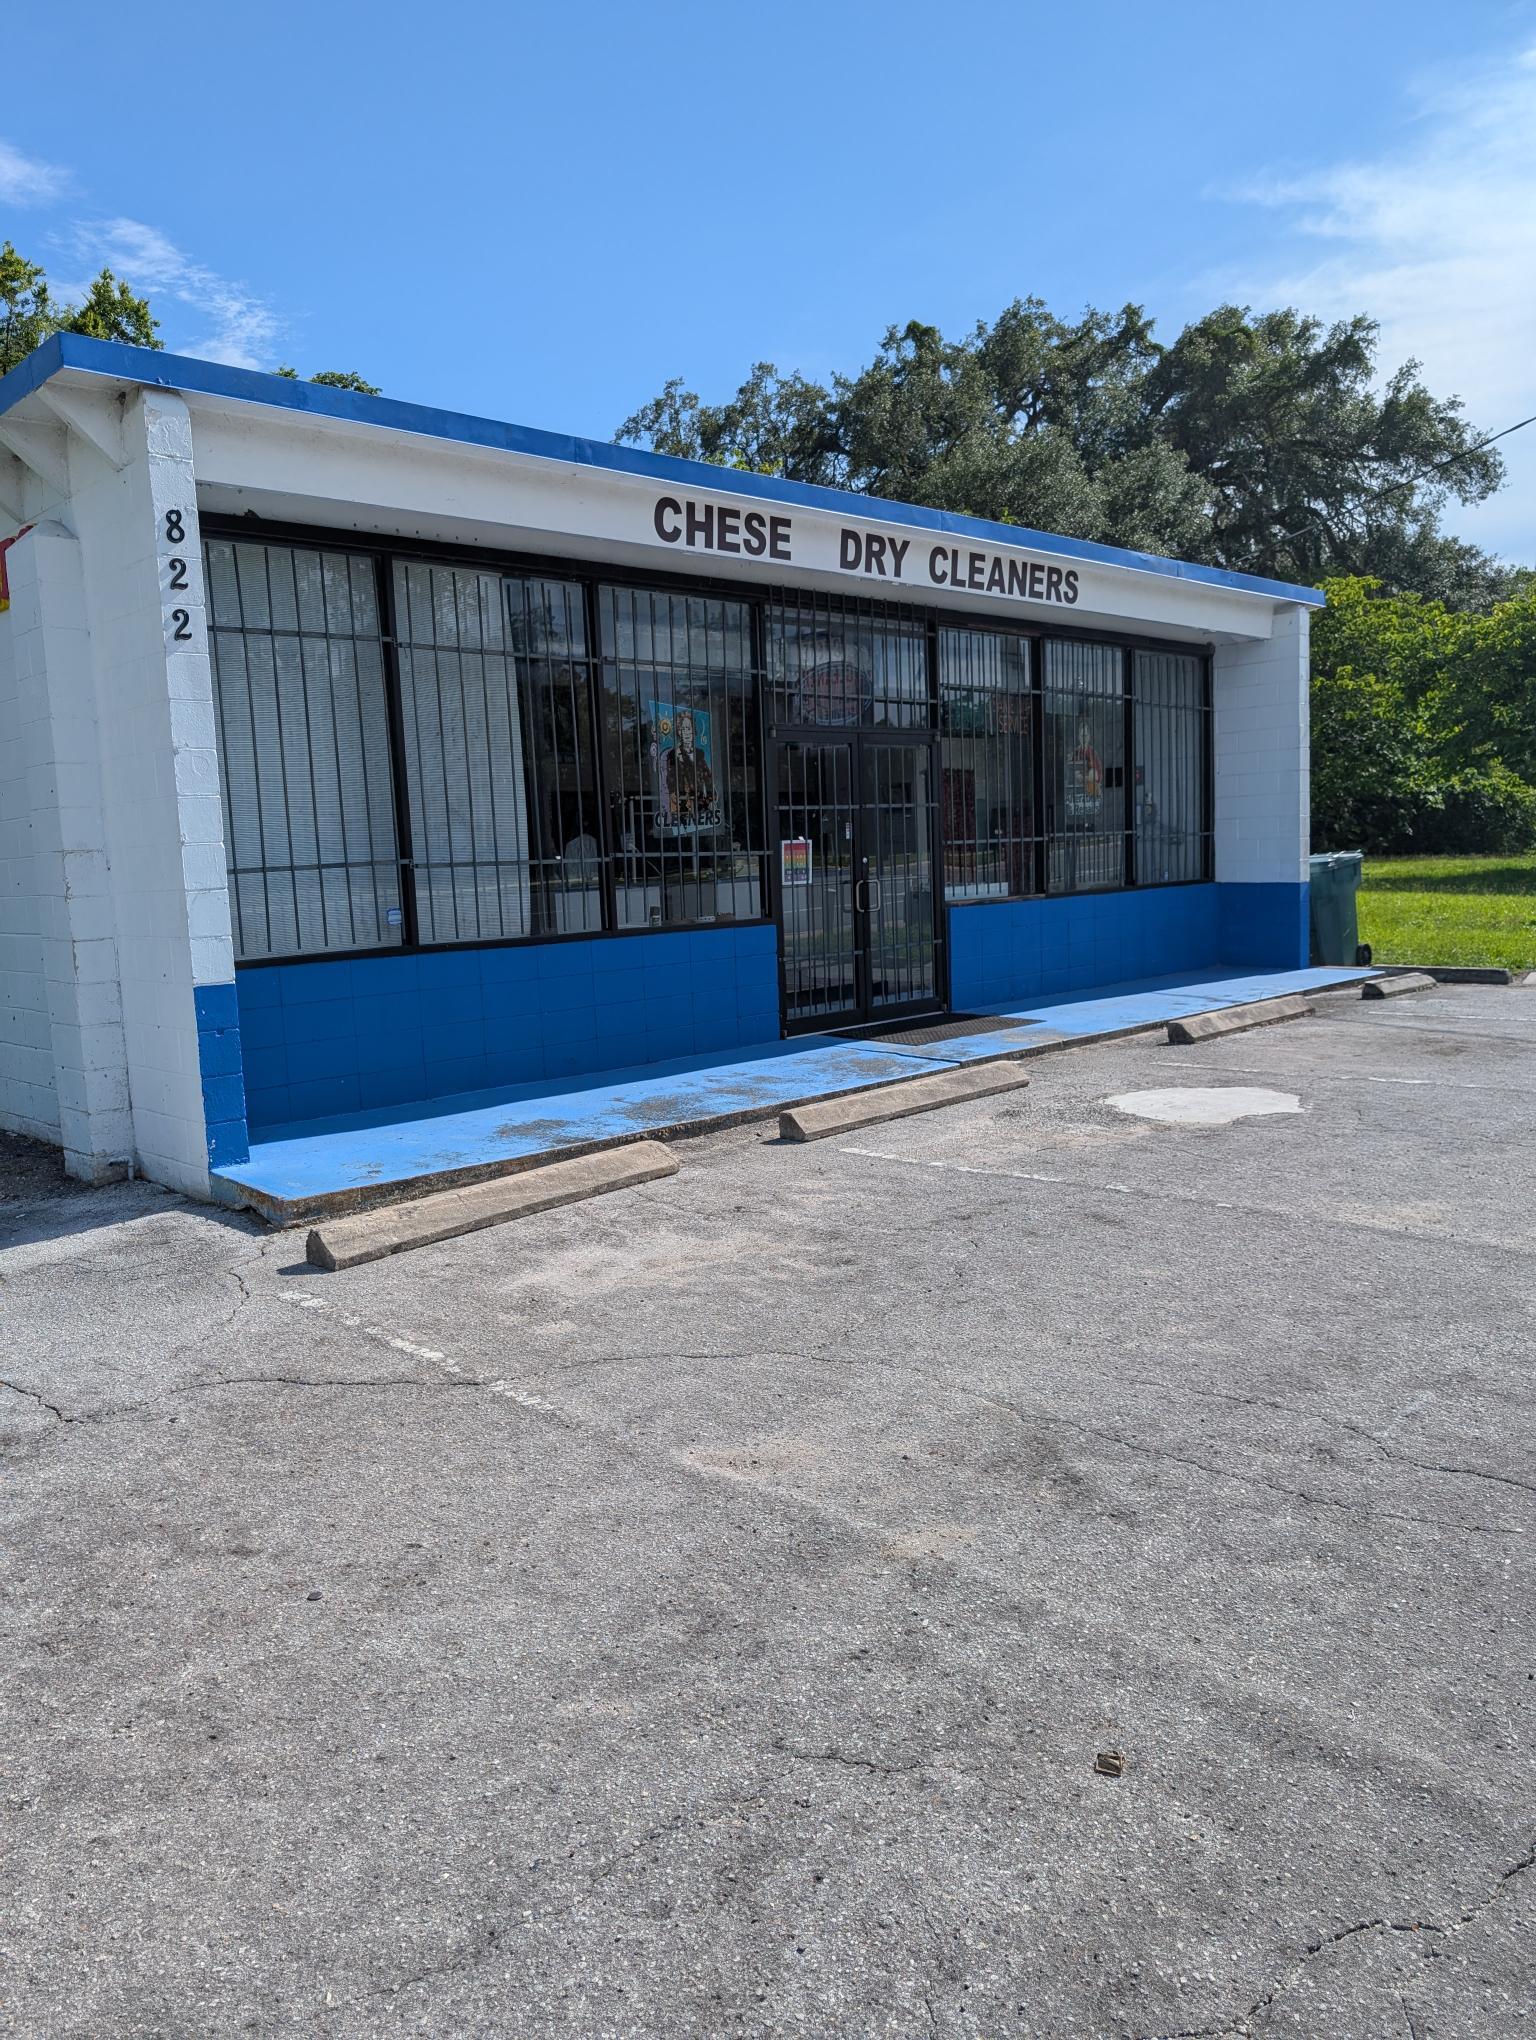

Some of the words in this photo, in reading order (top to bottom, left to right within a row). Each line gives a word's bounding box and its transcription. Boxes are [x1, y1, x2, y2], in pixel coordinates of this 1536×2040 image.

[165, 509, 193, 641] 822
[653, 496, 792, 561] CHESE
[839, 528, 911, 579] DRY
[928, 546, 1080, 605] CLEANERS
